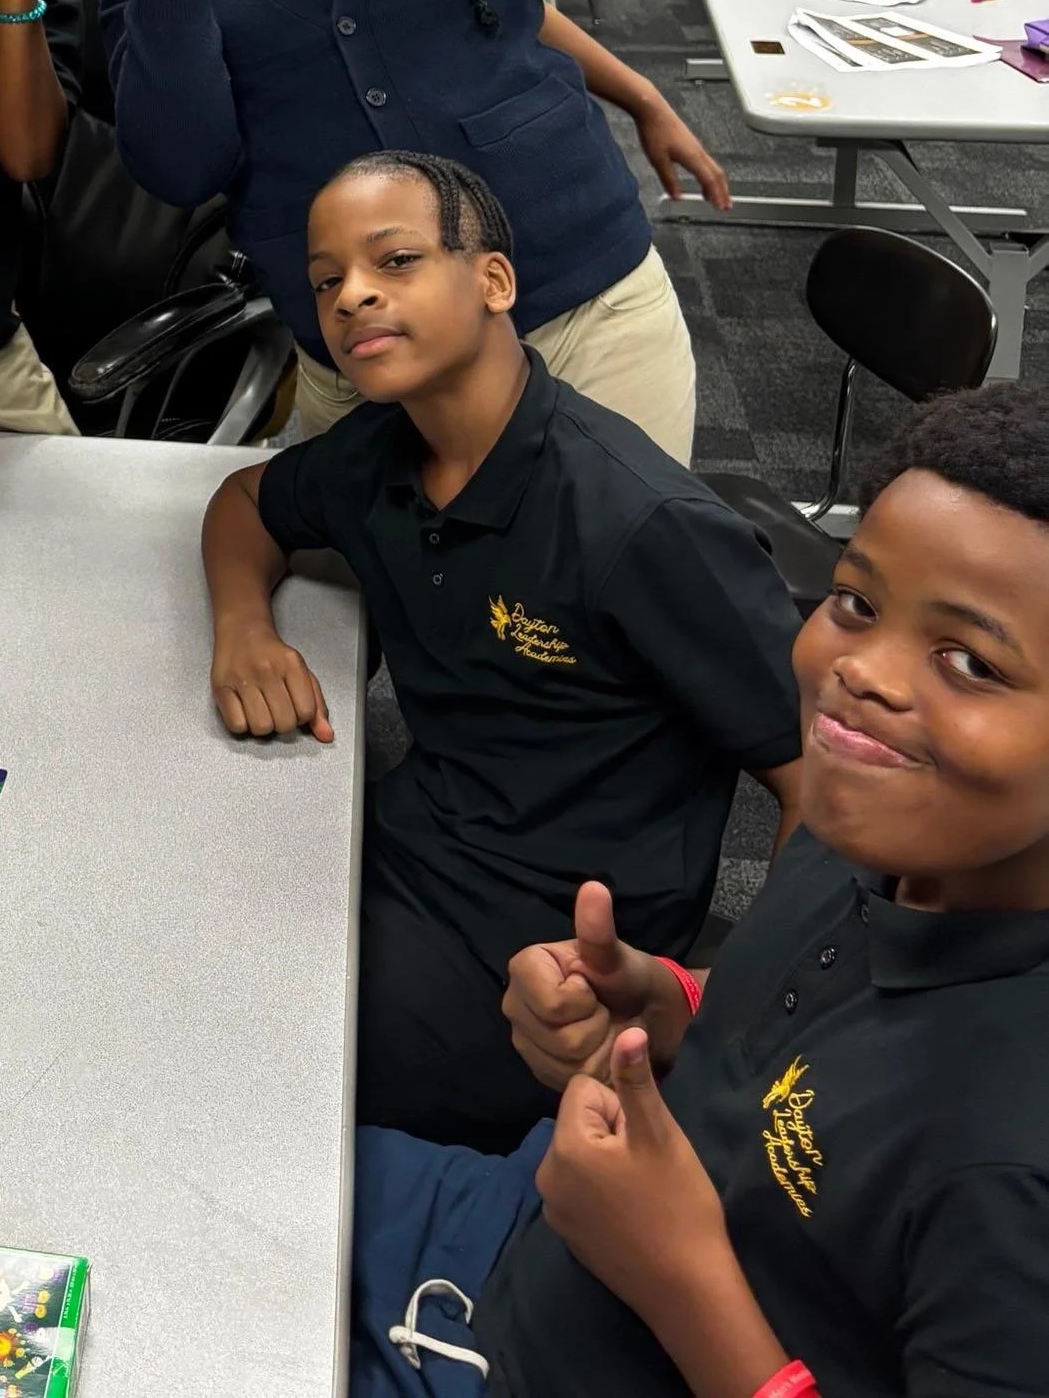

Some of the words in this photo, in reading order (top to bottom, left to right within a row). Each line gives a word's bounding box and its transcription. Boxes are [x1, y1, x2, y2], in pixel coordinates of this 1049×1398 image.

[510, 623, 570, 652] Leadership
[511, 602, 559, 634] Dayton
[514, 642, 577, 664] Academies
[773, 1108, 818, 1194] Leadership
[787, 1089, 823, 1166] Dayton
[762, 1129, 813, 1218] Academies
